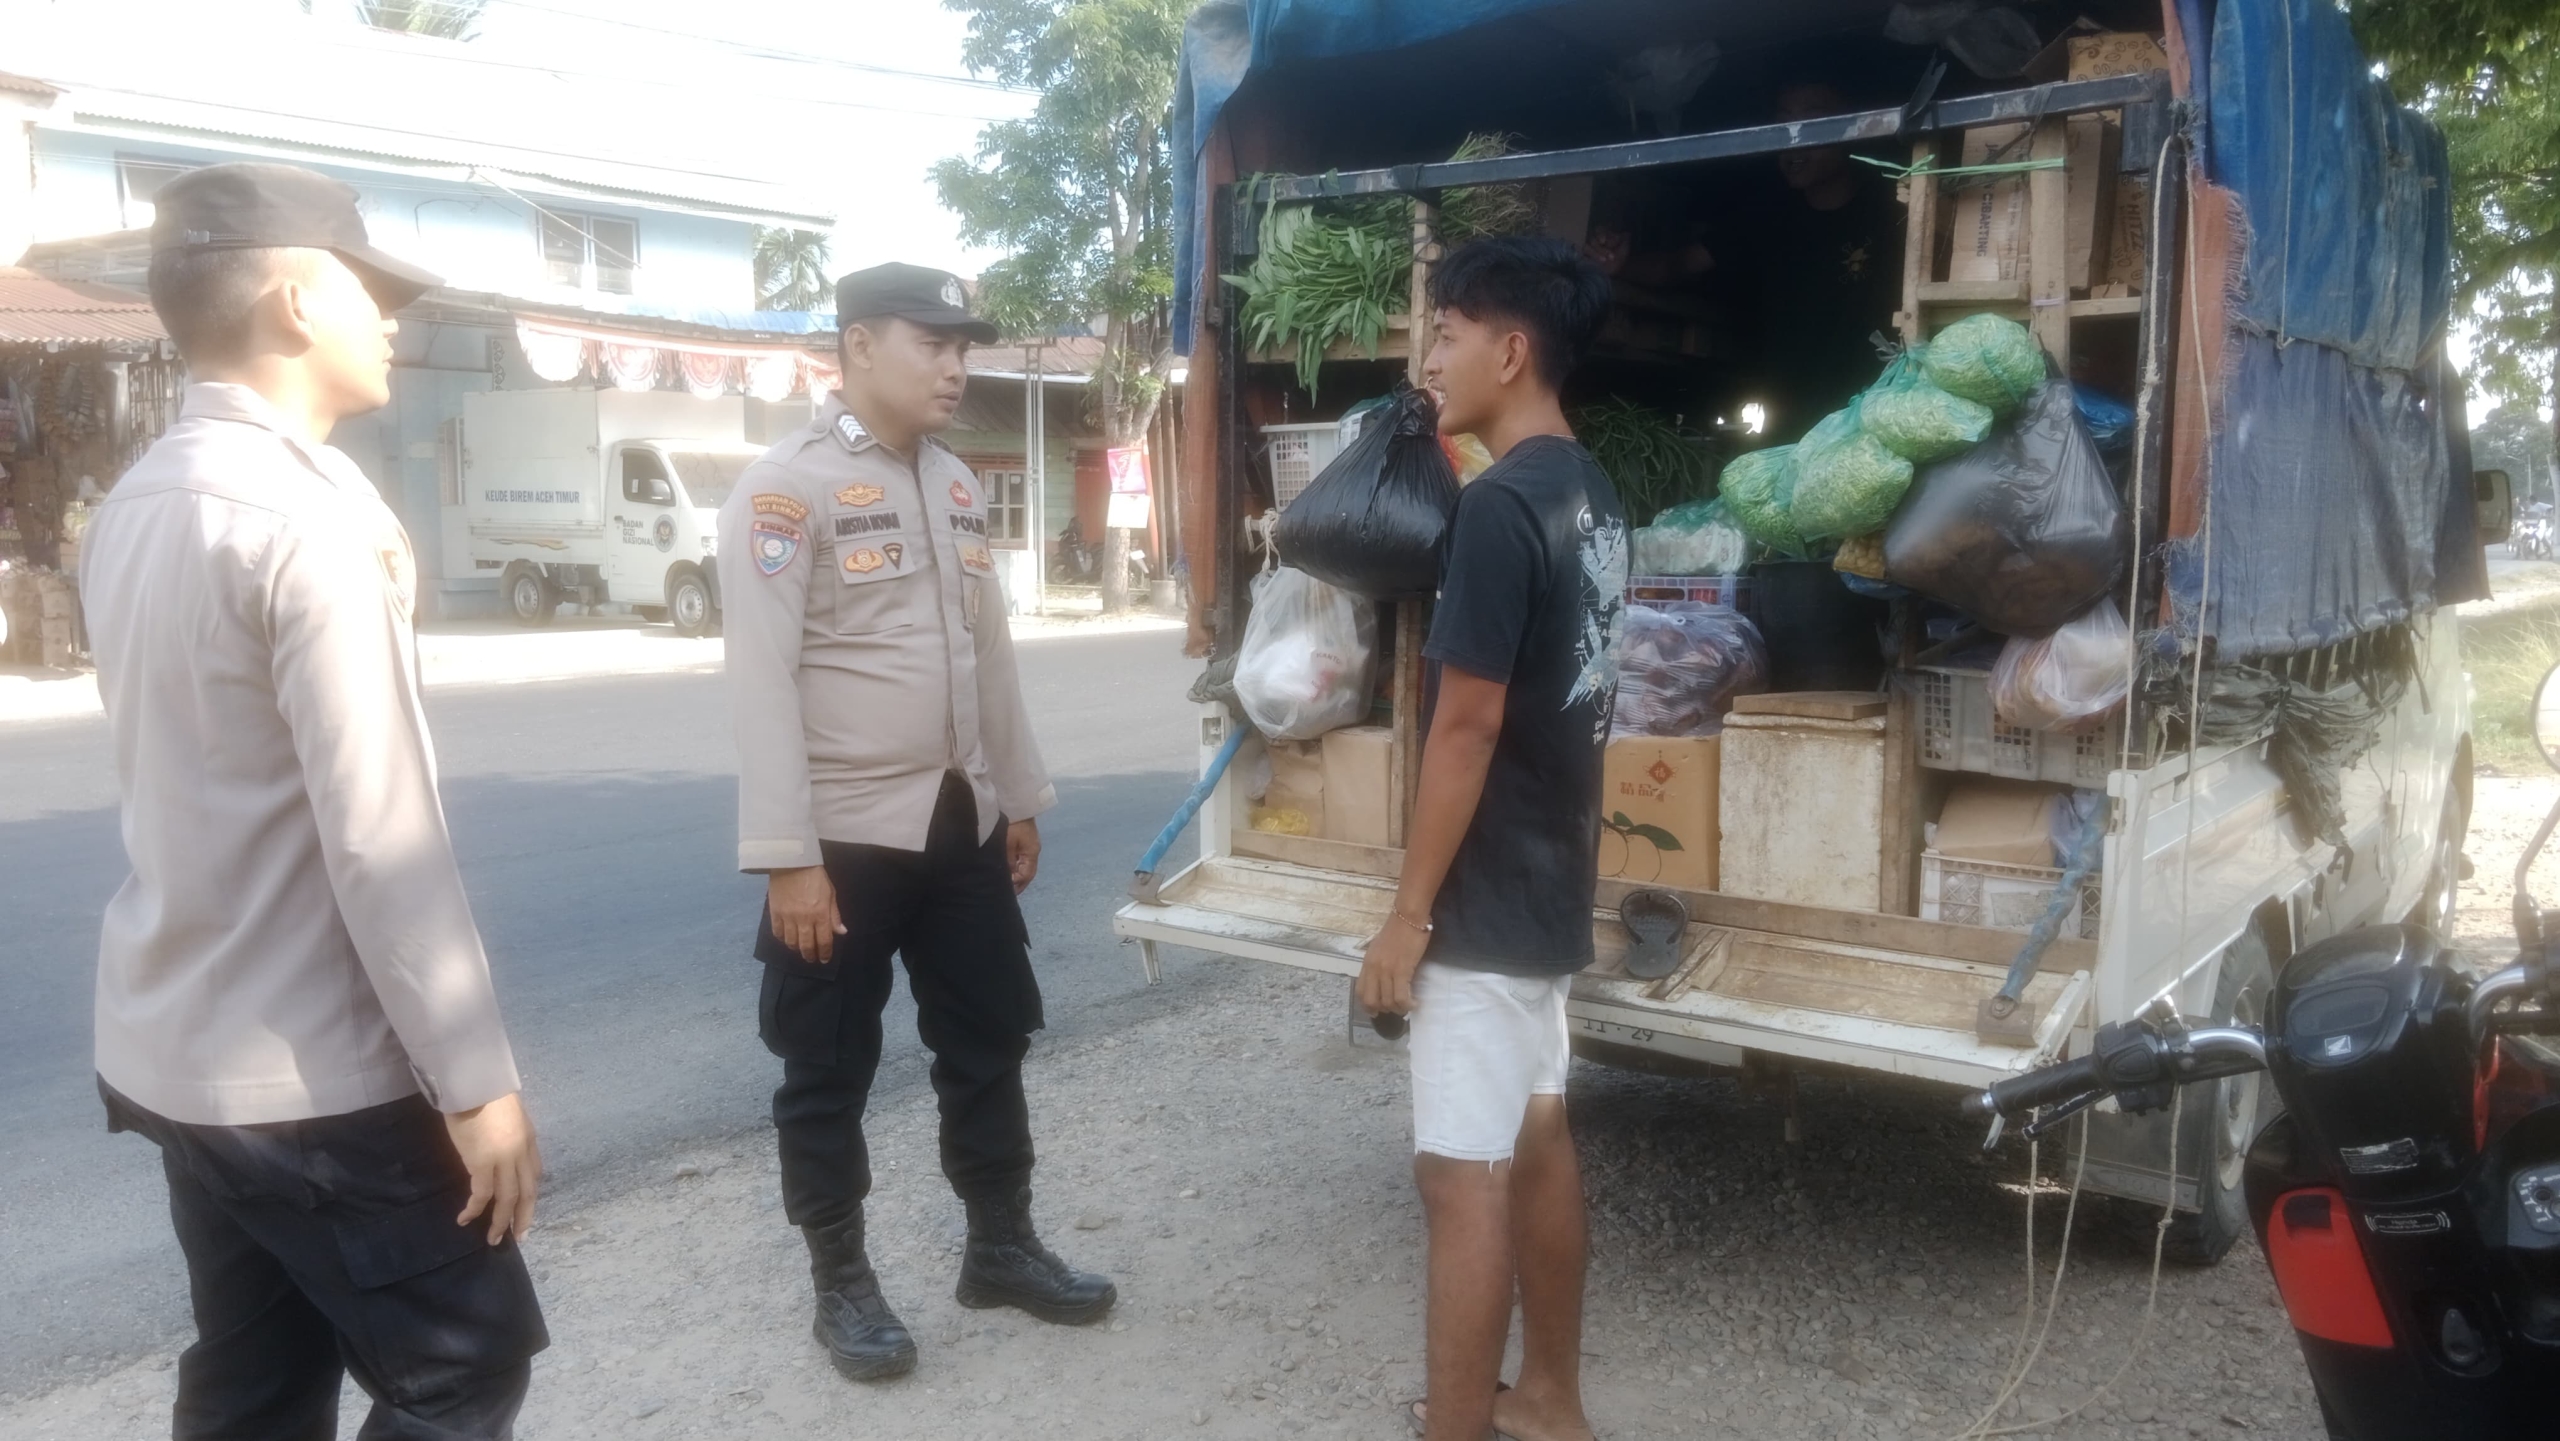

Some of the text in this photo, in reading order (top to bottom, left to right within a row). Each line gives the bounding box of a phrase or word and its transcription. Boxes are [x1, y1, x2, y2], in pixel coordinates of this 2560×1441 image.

[485, 490, 580, 503] KEUDE BIREM ACEH TIMUR
[772, 503, 801, 519] BINMAS
[622, 519, 644, 528] BADAN
[622, 528, 636, 536] GIZI
[622, 537, 655, 546] NASIONAL
